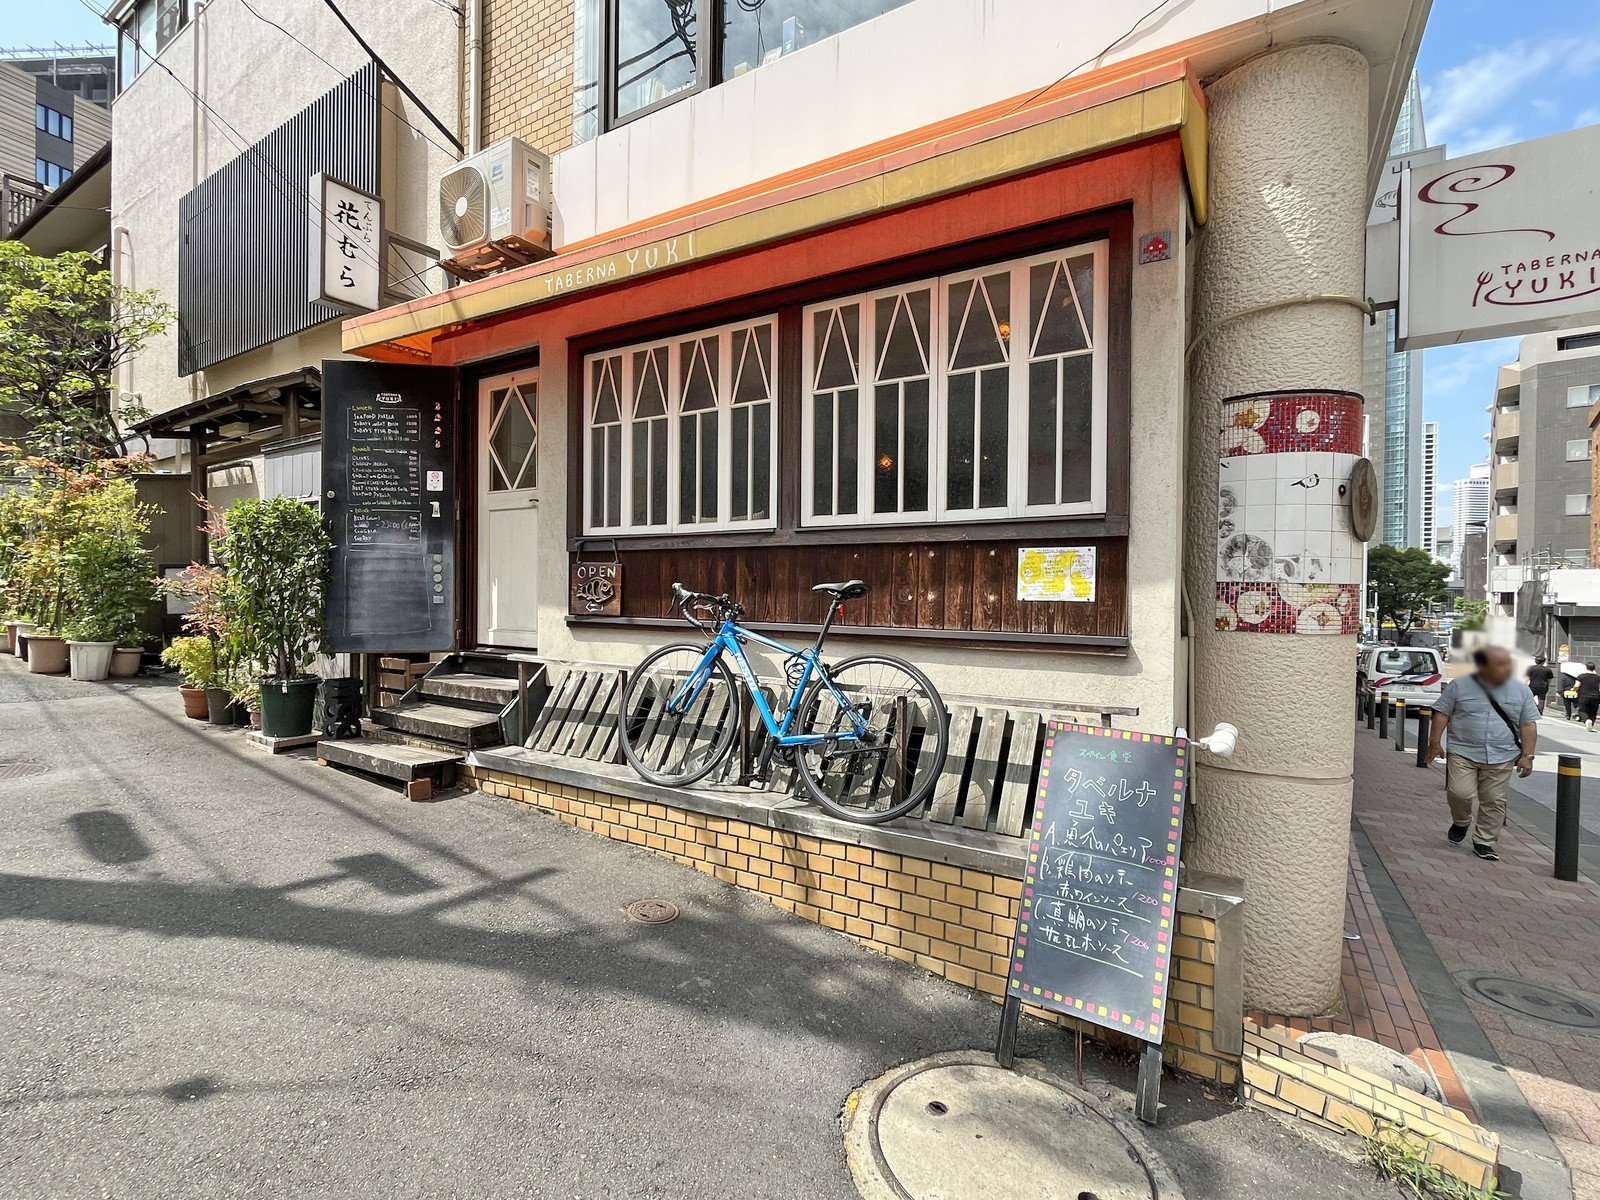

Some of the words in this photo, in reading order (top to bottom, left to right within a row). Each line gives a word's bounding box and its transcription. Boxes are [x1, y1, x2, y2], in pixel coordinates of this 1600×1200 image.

[333, 199, 362, 288] 花むら
[544, 261, 616, 293] TABERNA
[625, 233, 694, 274] YUKI
[1501, 248, 1600, 275] TABERNA
[1504, 266, 1596, 299] YUKI
[577, 565, 616, 579] OPEN
[1079, 748, 1133, 763] スペイン食堂
[1063, 767, 1157, 808] タベルナ
[1068, 799, 1117, 825] ユキ
[1145, 855, 1168, 866] 1000
[1131, 891, 1159, 906] 1200
